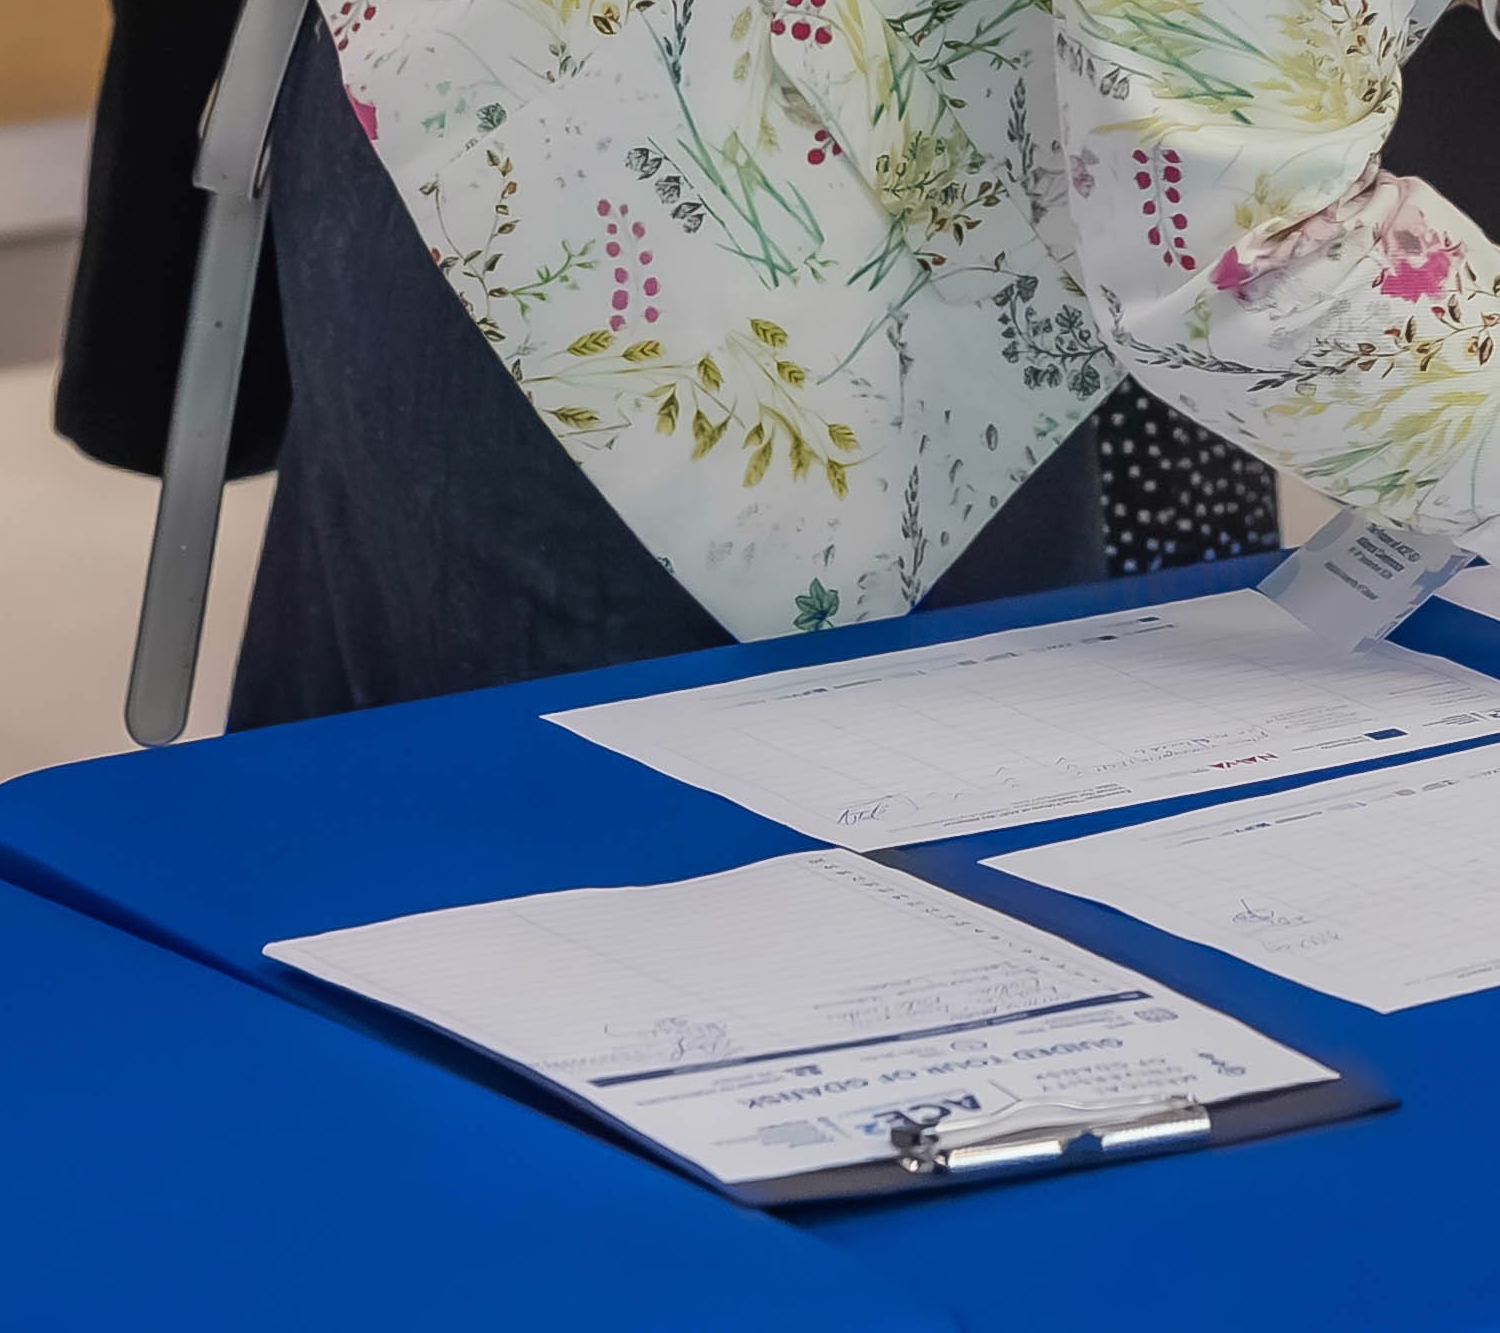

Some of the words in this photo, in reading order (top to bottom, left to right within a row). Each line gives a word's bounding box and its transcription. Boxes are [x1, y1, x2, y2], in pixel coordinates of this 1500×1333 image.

[1209, 752, 1279, 769] NAWA
[1013, 1037, 1125, 1061] GUIDED
[927, 1055, 1002, 1076] TOUR
[879, 1070, 917, 1083] OF
